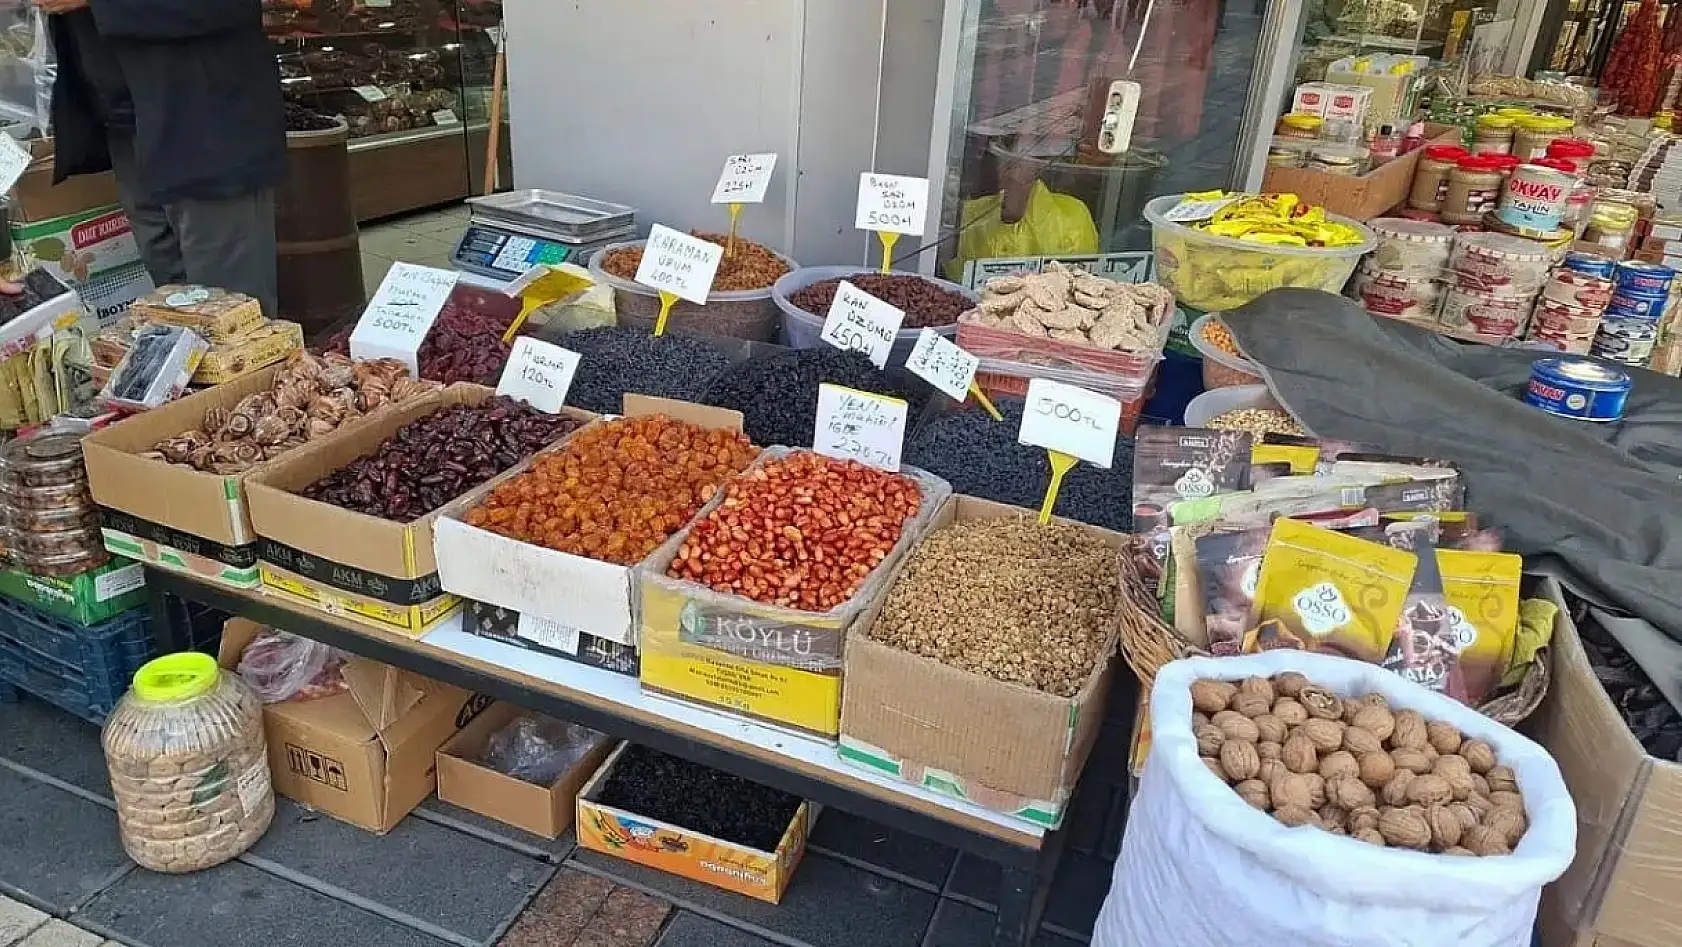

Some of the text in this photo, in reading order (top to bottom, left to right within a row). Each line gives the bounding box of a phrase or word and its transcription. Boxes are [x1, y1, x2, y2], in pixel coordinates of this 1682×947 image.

[1510, 179, 1562, 201] OKYAY
[1176, 481, 1213, 497] OSSO
[331, 566, 364, 589] AKM
[1297, 595, 1346, 622] OSSO
[715, 614, 813, 655] KÖYLÜ
